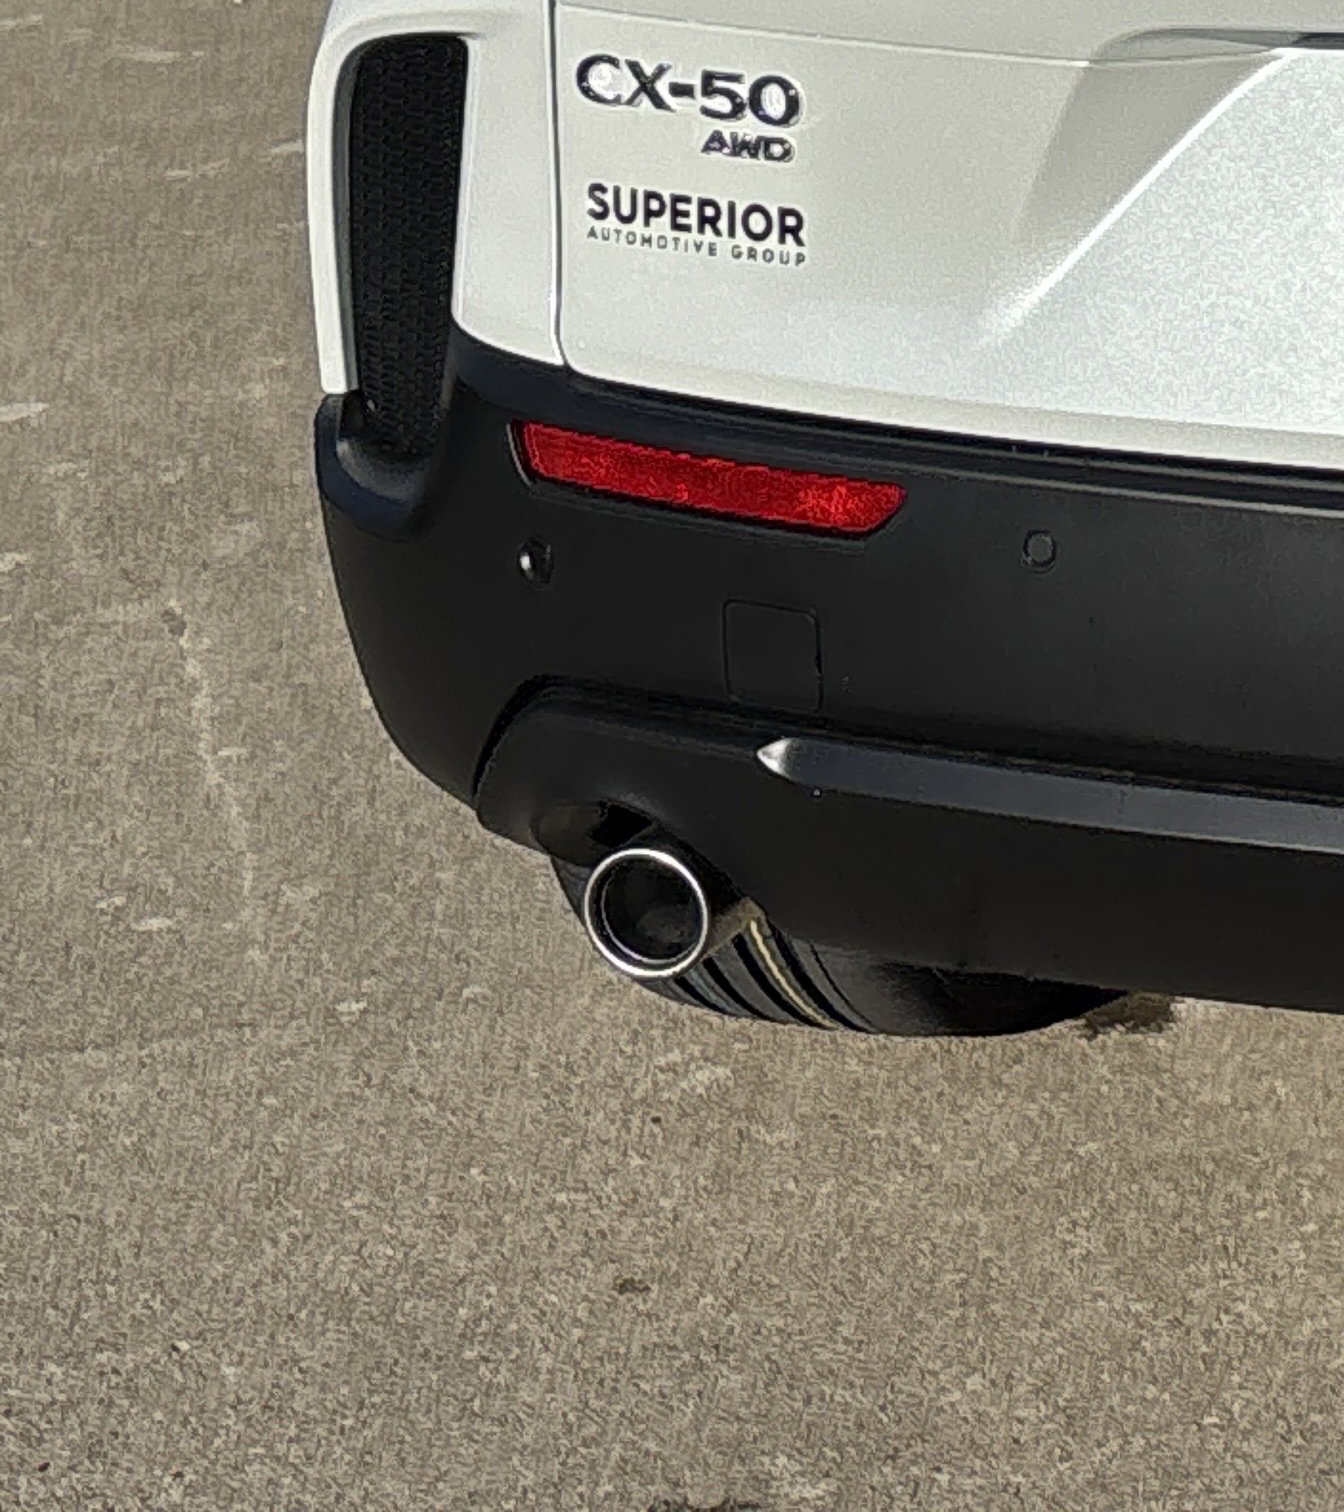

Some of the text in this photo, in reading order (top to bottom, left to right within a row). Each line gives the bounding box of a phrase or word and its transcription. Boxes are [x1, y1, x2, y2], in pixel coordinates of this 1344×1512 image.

[575, 53, 802, 128] CX-50
[700, 129, 796, 163] AWD
[585, 181, 806, 248] SUPERIOR
[585, 225, 806, 267] AUTOMOTIVE GROUP
